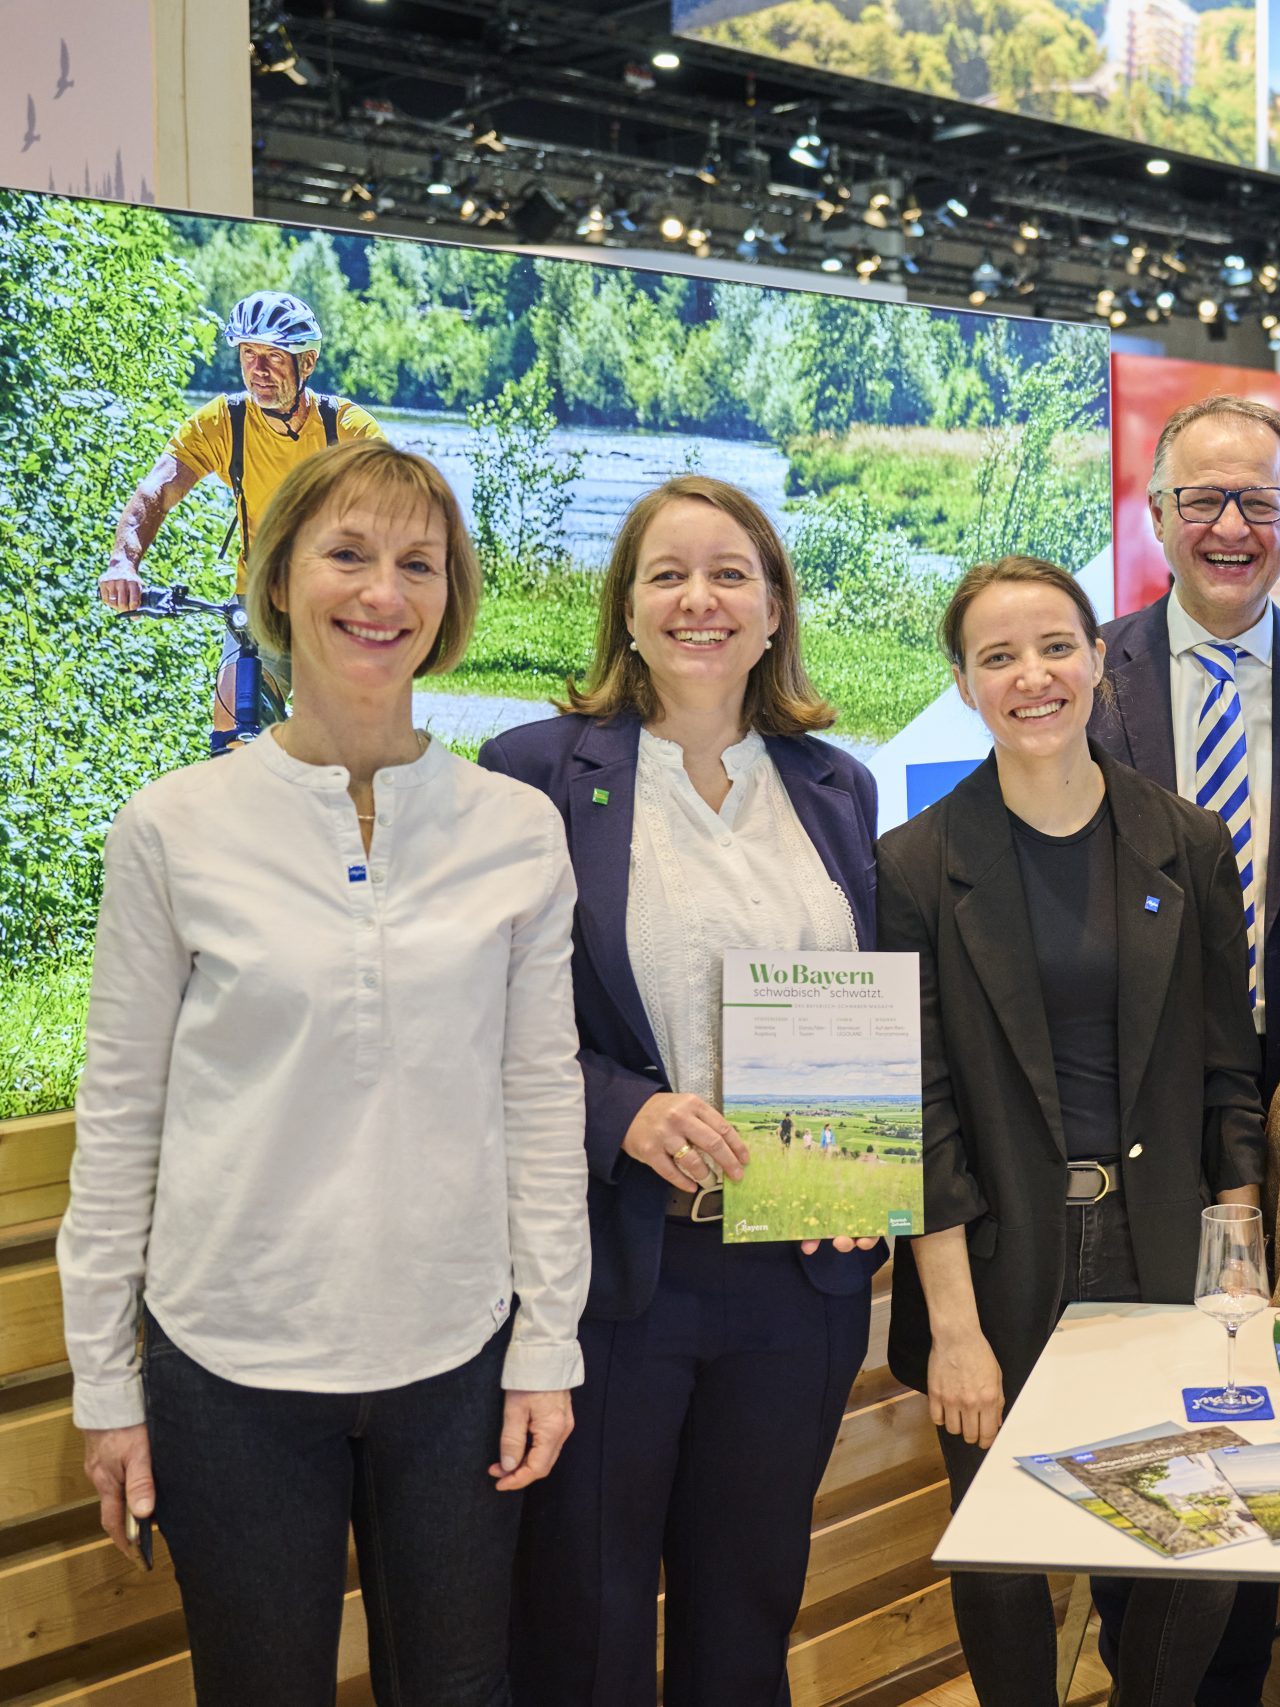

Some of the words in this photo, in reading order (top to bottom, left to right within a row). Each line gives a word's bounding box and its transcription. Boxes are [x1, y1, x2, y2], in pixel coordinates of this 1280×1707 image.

[749, 963, 788, 984] Wo
[792, 964, 874, 990] Bayern
[753, 986, 821, 998] schwäbisch
